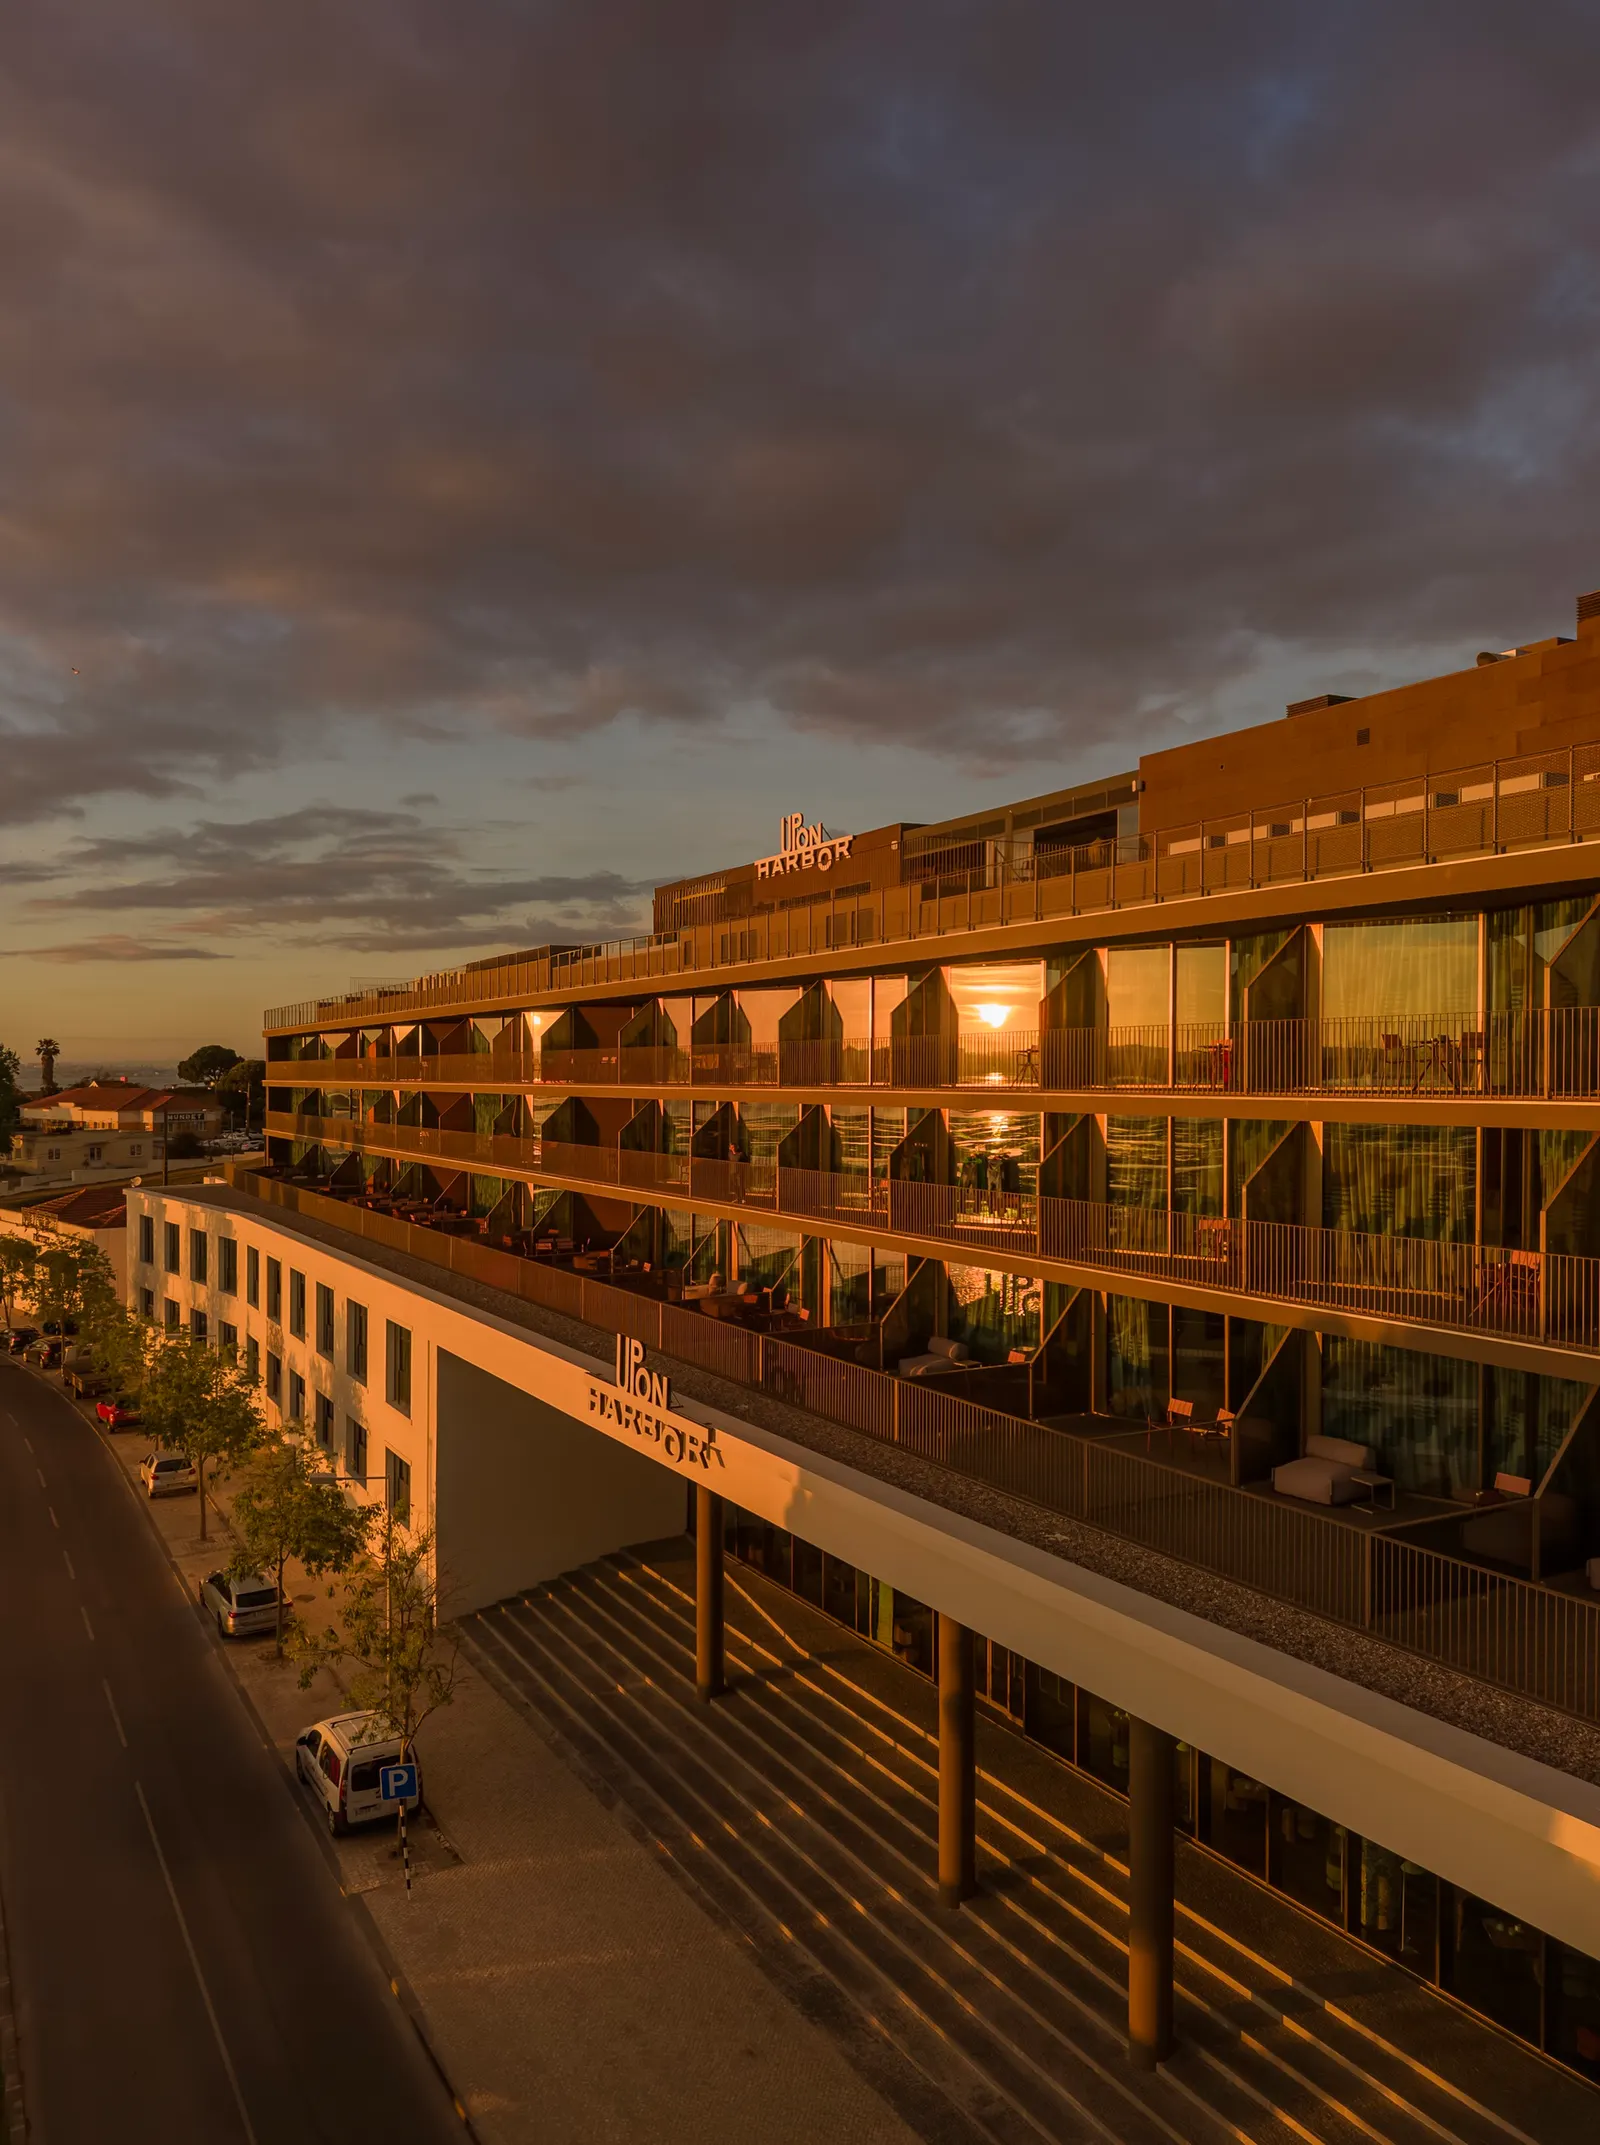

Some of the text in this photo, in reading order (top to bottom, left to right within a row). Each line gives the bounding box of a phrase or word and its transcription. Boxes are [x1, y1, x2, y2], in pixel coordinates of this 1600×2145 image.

[754, 834, 854, 881] HARBOR
[586, 1377, 715, 1470] HARBOR
[387, 1769, 409, 1797] P
